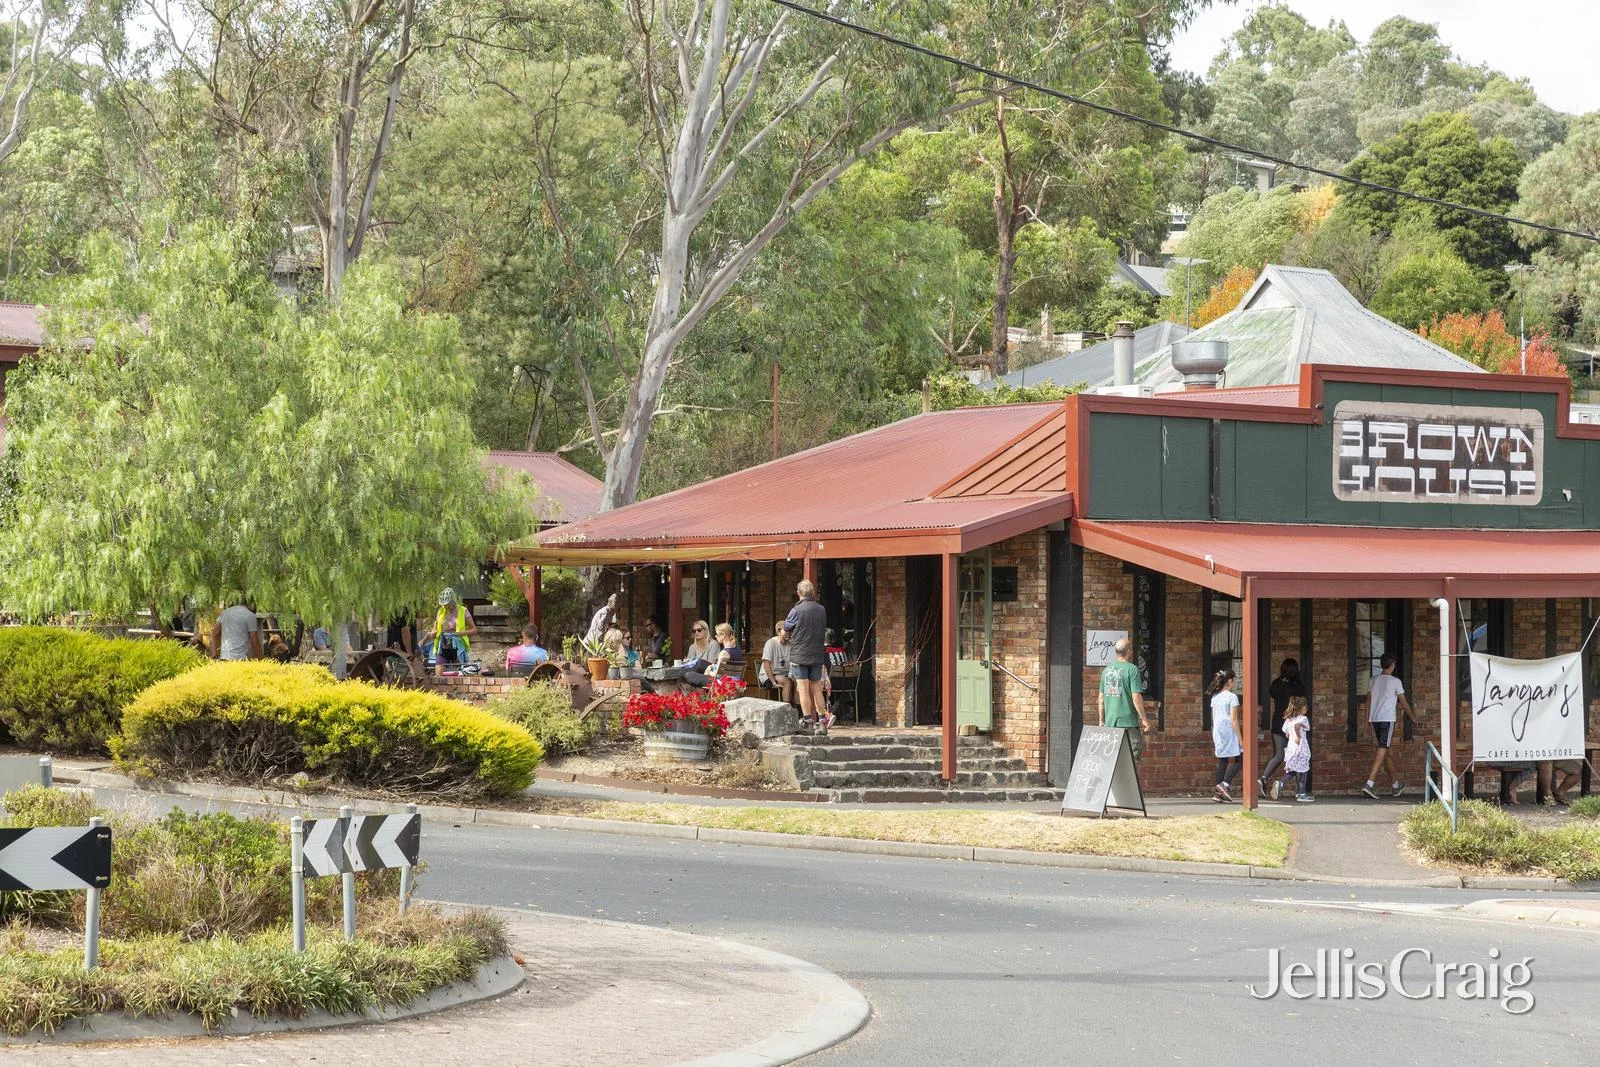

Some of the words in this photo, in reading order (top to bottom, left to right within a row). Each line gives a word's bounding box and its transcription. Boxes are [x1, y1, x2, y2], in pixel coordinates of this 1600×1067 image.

[1477, 658, 1579, 742] Langan's
[1080, 729, 1119, 757] Langan's
[1488, 750, 1509, 758] CAFE
[1525, 748, 1572, 757] FOODSTORE
